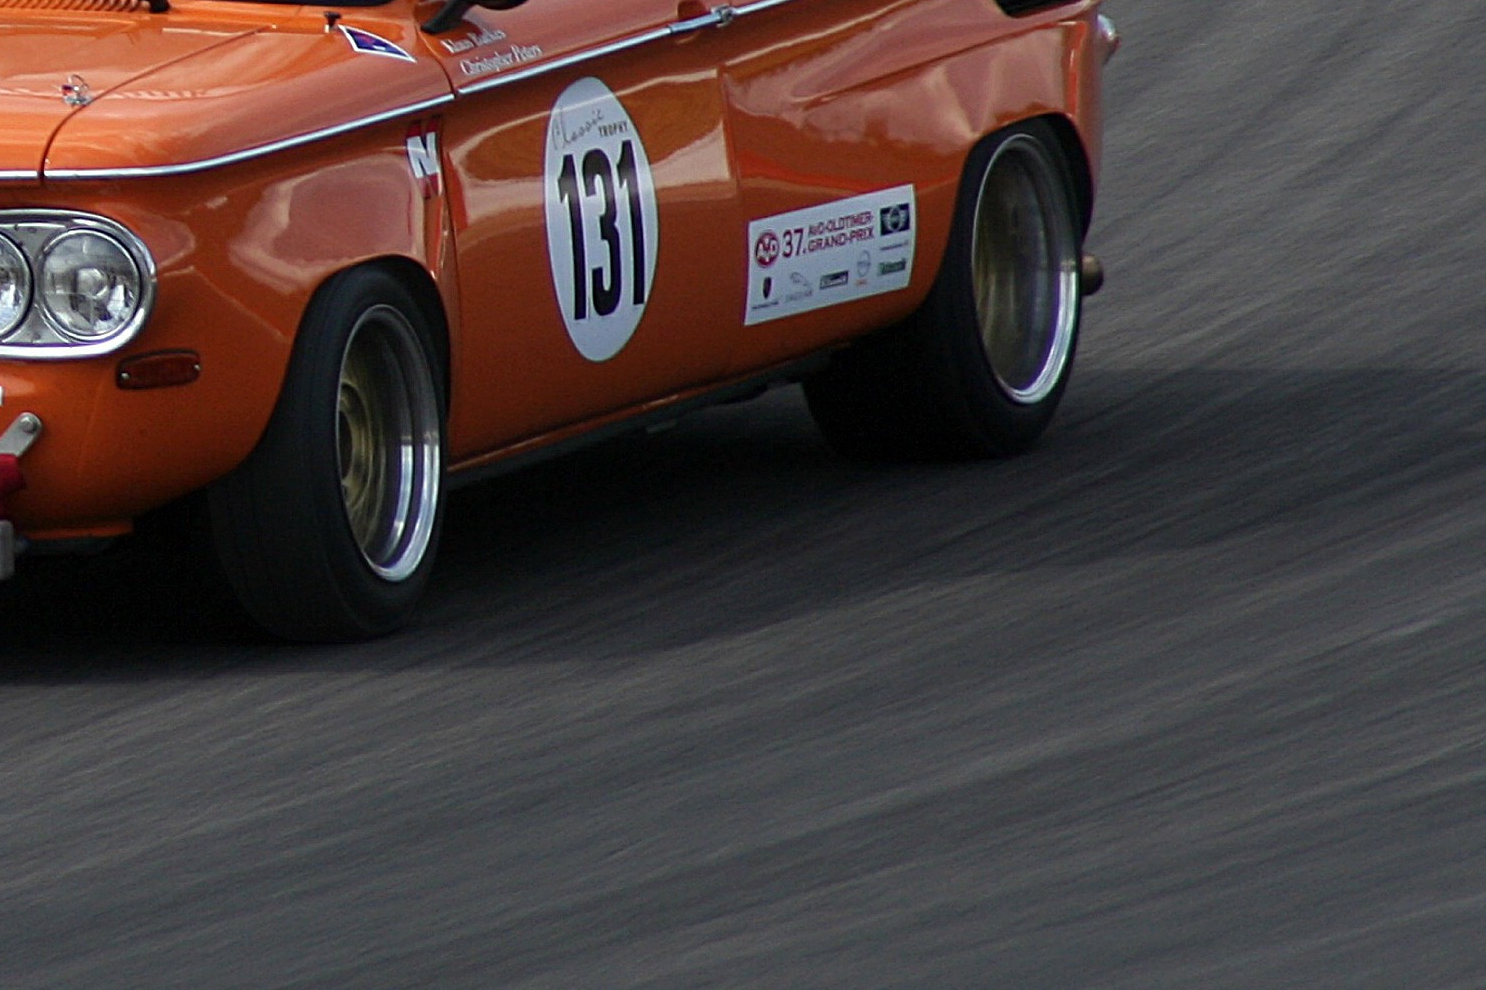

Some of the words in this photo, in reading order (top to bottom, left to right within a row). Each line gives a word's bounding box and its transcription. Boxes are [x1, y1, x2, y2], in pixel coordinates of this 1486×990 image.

[551, 105, 606, 151] Classic
[597, 120, 630, 139] TROPHY
[556, 139, 646, 321] 131
[807, 227, 875, 253] GRAND-PRIX
